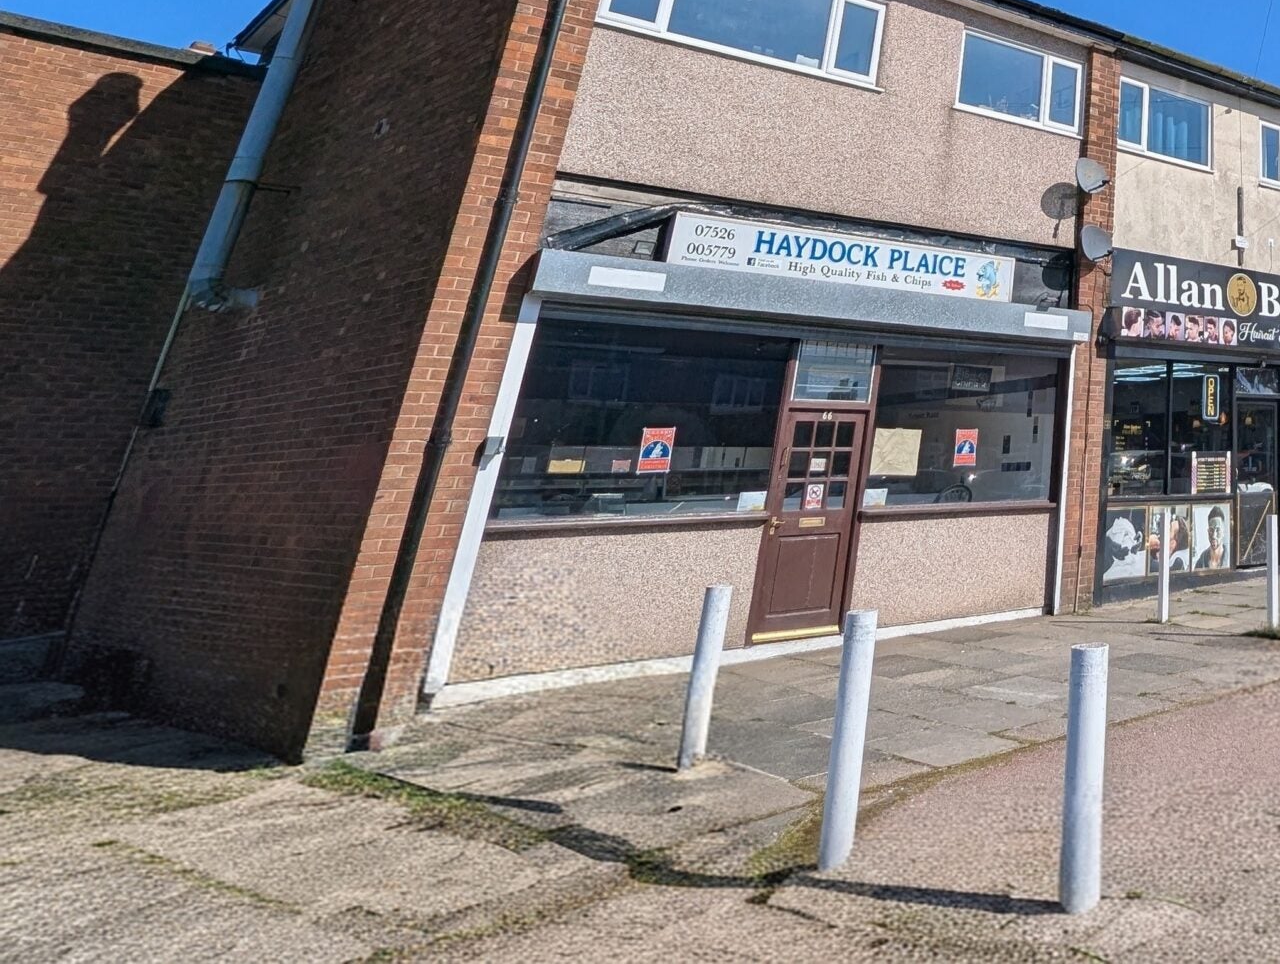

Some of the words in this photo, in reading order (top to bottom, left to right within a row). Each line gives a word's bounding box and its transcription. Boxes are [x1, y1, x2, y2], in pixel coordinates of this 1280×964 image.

[695, 224, 735, 240] 07526
[687, 242, 736, 259] 005779
[754, 230, 880, 267] HAYDOCK
[888, 249, 966, 277] PLAICE
[788, 261, 816, 276] High
[821, 265, 861, 281] Quality
[866, 270, 887, 282] Fish
[891, 273, 900, 283] &
[904, 274, 932, 288] Chips
[1121, 261, 1225, 311] Allan
[1207, 378, 1215, 416] OPEN
[822, 412, 833, 421] 66
